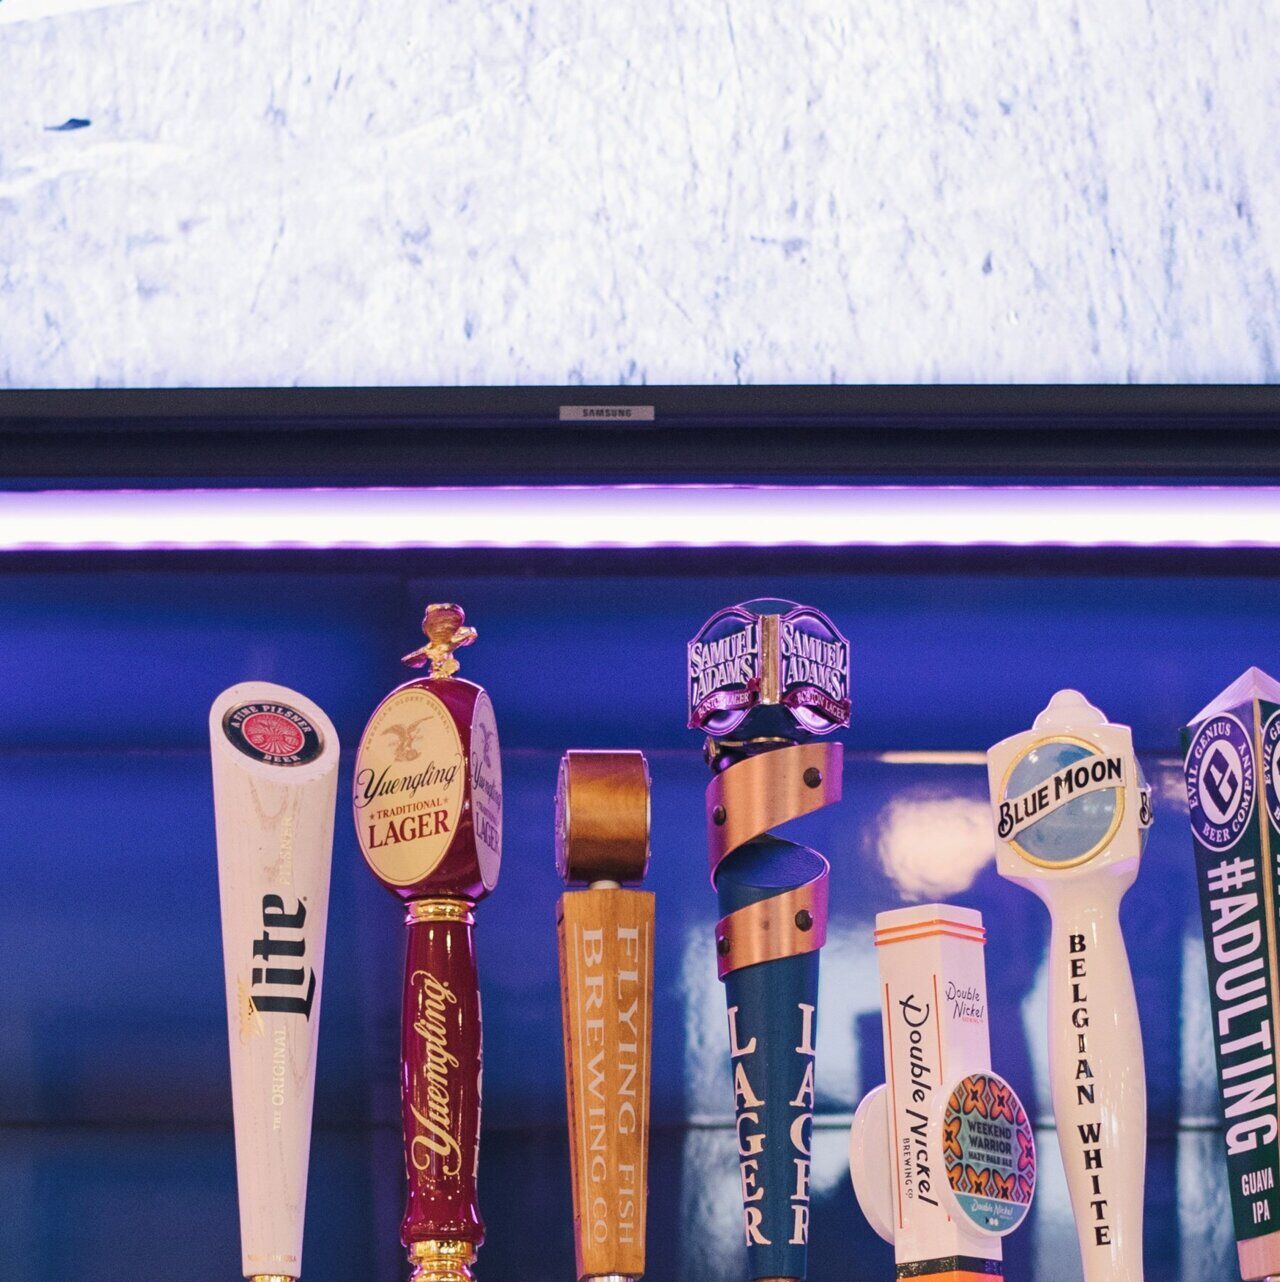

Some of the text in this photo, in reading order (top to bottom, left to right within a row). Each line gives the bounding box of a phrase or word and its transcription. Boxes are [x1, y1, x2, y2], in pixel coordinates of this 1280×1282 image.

[582, 408, 633, 418] SAMSUNG
[690, 623, 758, 678] SAMUEL
[781, 622, 847, 675] SAMUEL
[696, 655, 754, 699] ADAMS
[786, 657, 842, 701] ADAMS
[233, 705, 259, 721] FINE
[262, 705, 312, 733] PILSNER
[263, 754, 301, 763] BEER
[354, 753, 463, 809] Yuengling
[1187, 722, 1231, 809] EVIL GENIUS
[1263, 744, 1273, 785] EVIL
[376, 797, 443, 820] TRADITIONAL
[998, 756, 1123, 839] BLUE MOON
[1202, 742, 1252, 843] BEER COMPANY
[368, 809, 451, 850] LAGER
[250, 893, 317, 1023] Lite
[945, 981, 981, 1002] Double
[952, 999, 985, 1019] Nickel
[1207, 856, 1278, 1156] #ADULTING
[271, 1025, 287, 1107] ORIGINAL
[410, 969, 462, 1177] Yuengling
[582, 927, 609, 1185] BREWING
[616, 925, 640, 1245] FLYING FISH
[898, 994, 939, 1207] Double Nickel
[1069, 933, 1112, 1247] BELGIAN WHITE
[726, 1005, 773, 1247] LAGER
[966, 1119, 1013, 1140] WEEKEND
[968, 1134, 1013, 1155] WARRIOR
[902, 1137, 914, 1187] BREWING
[968, 1150, 1013, 1168] HAZY PALE ALE
[1241, 1166, 1274, 1197] GUAVA
[1252, 1199, 1271, 1225] IPA
